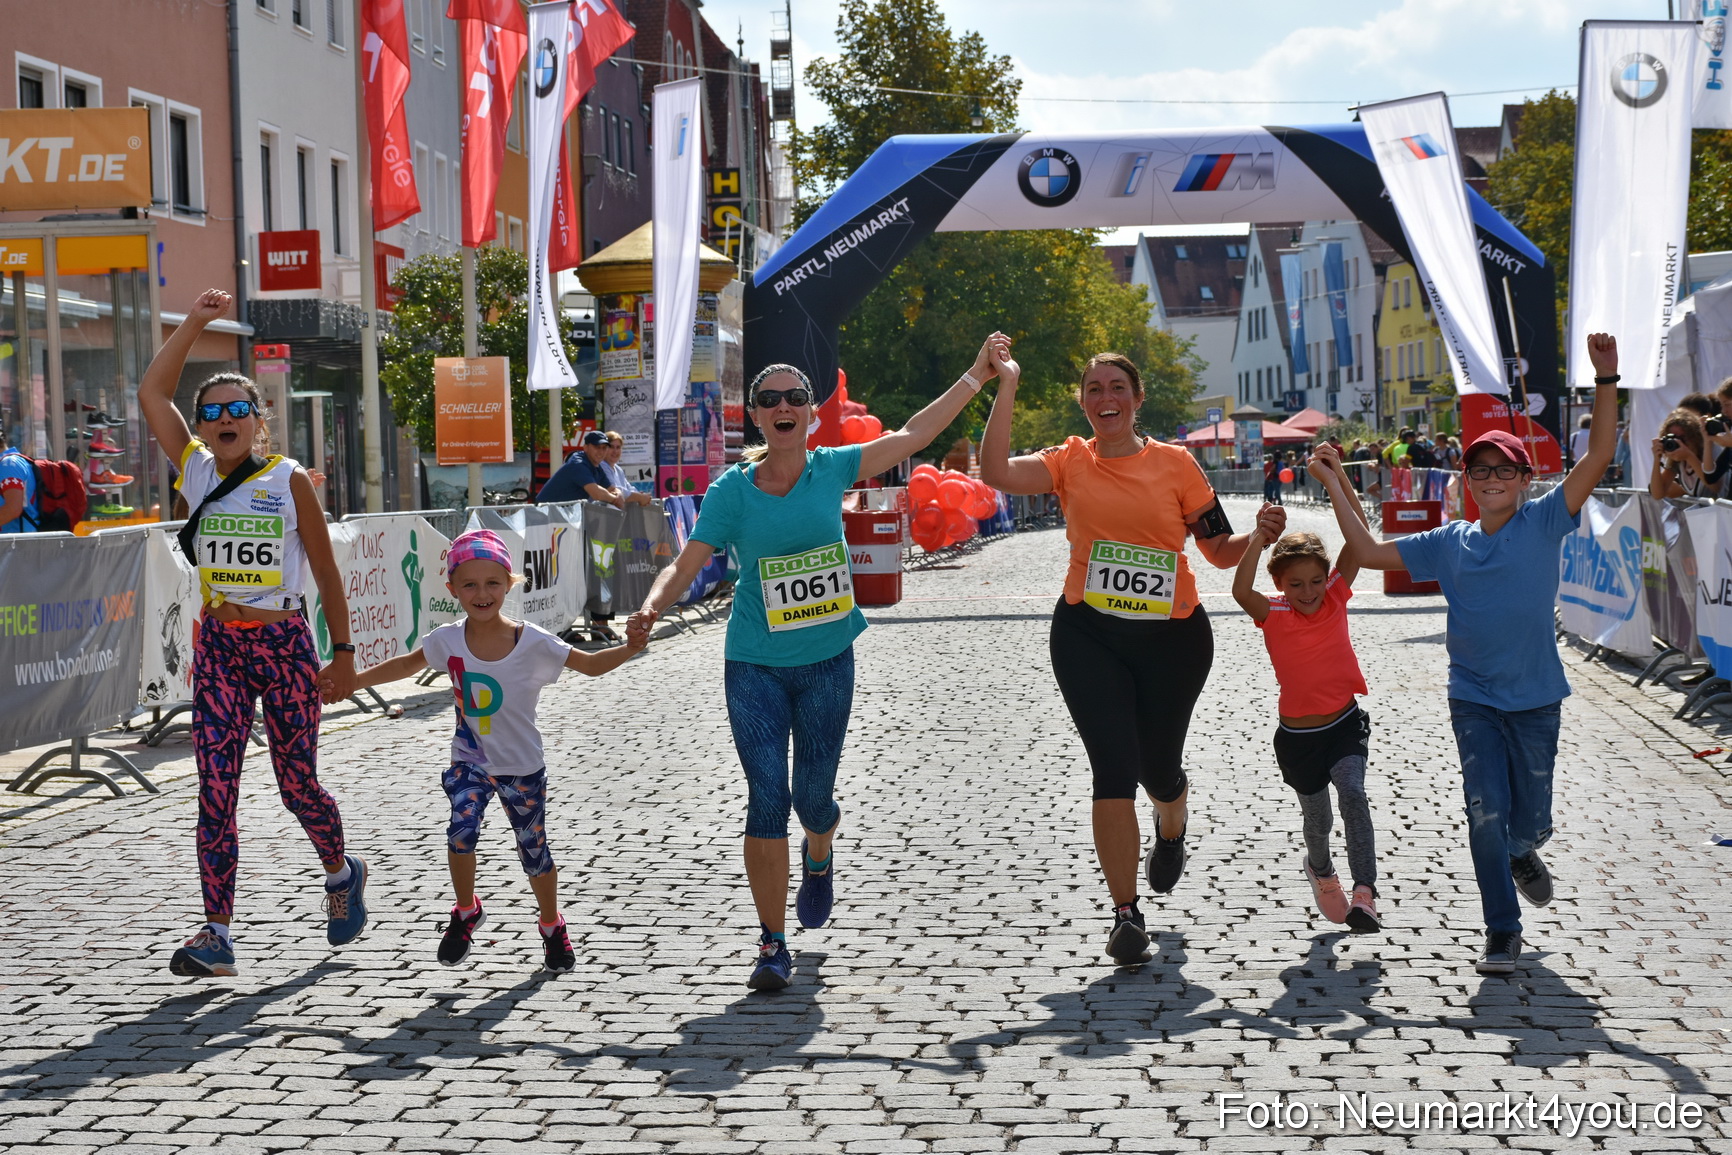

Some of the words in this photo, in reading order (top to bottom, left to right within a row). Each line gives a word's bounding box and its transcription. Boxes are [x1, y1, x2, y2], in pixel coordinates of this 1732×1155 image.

[1024, 148, 1075, 167] BMW
[774, 257, 826, 296] PARTL
[823, 197, 912, 263] NEUMARKT
[267, 250, 309, 266] WITT
[1662, 242, 1678, 328] NEUMARKT
[439, 402, 502, 414] SCHNELLER!
[204, 517, 277, 535] BOCK
[207, 541, 273, 565] 1166
[766, 546, 841, 577] BOCK
[1096, 543, 1169, 569] BOCK
[211, 572, 263, 583] RENATA
[774, 571, 840, 604] 1061
[1098, 567, 1164, 597] 1062
[783, 602, 840, 621] DANIELA
[1106, 598, 1148, 611] TANJA
